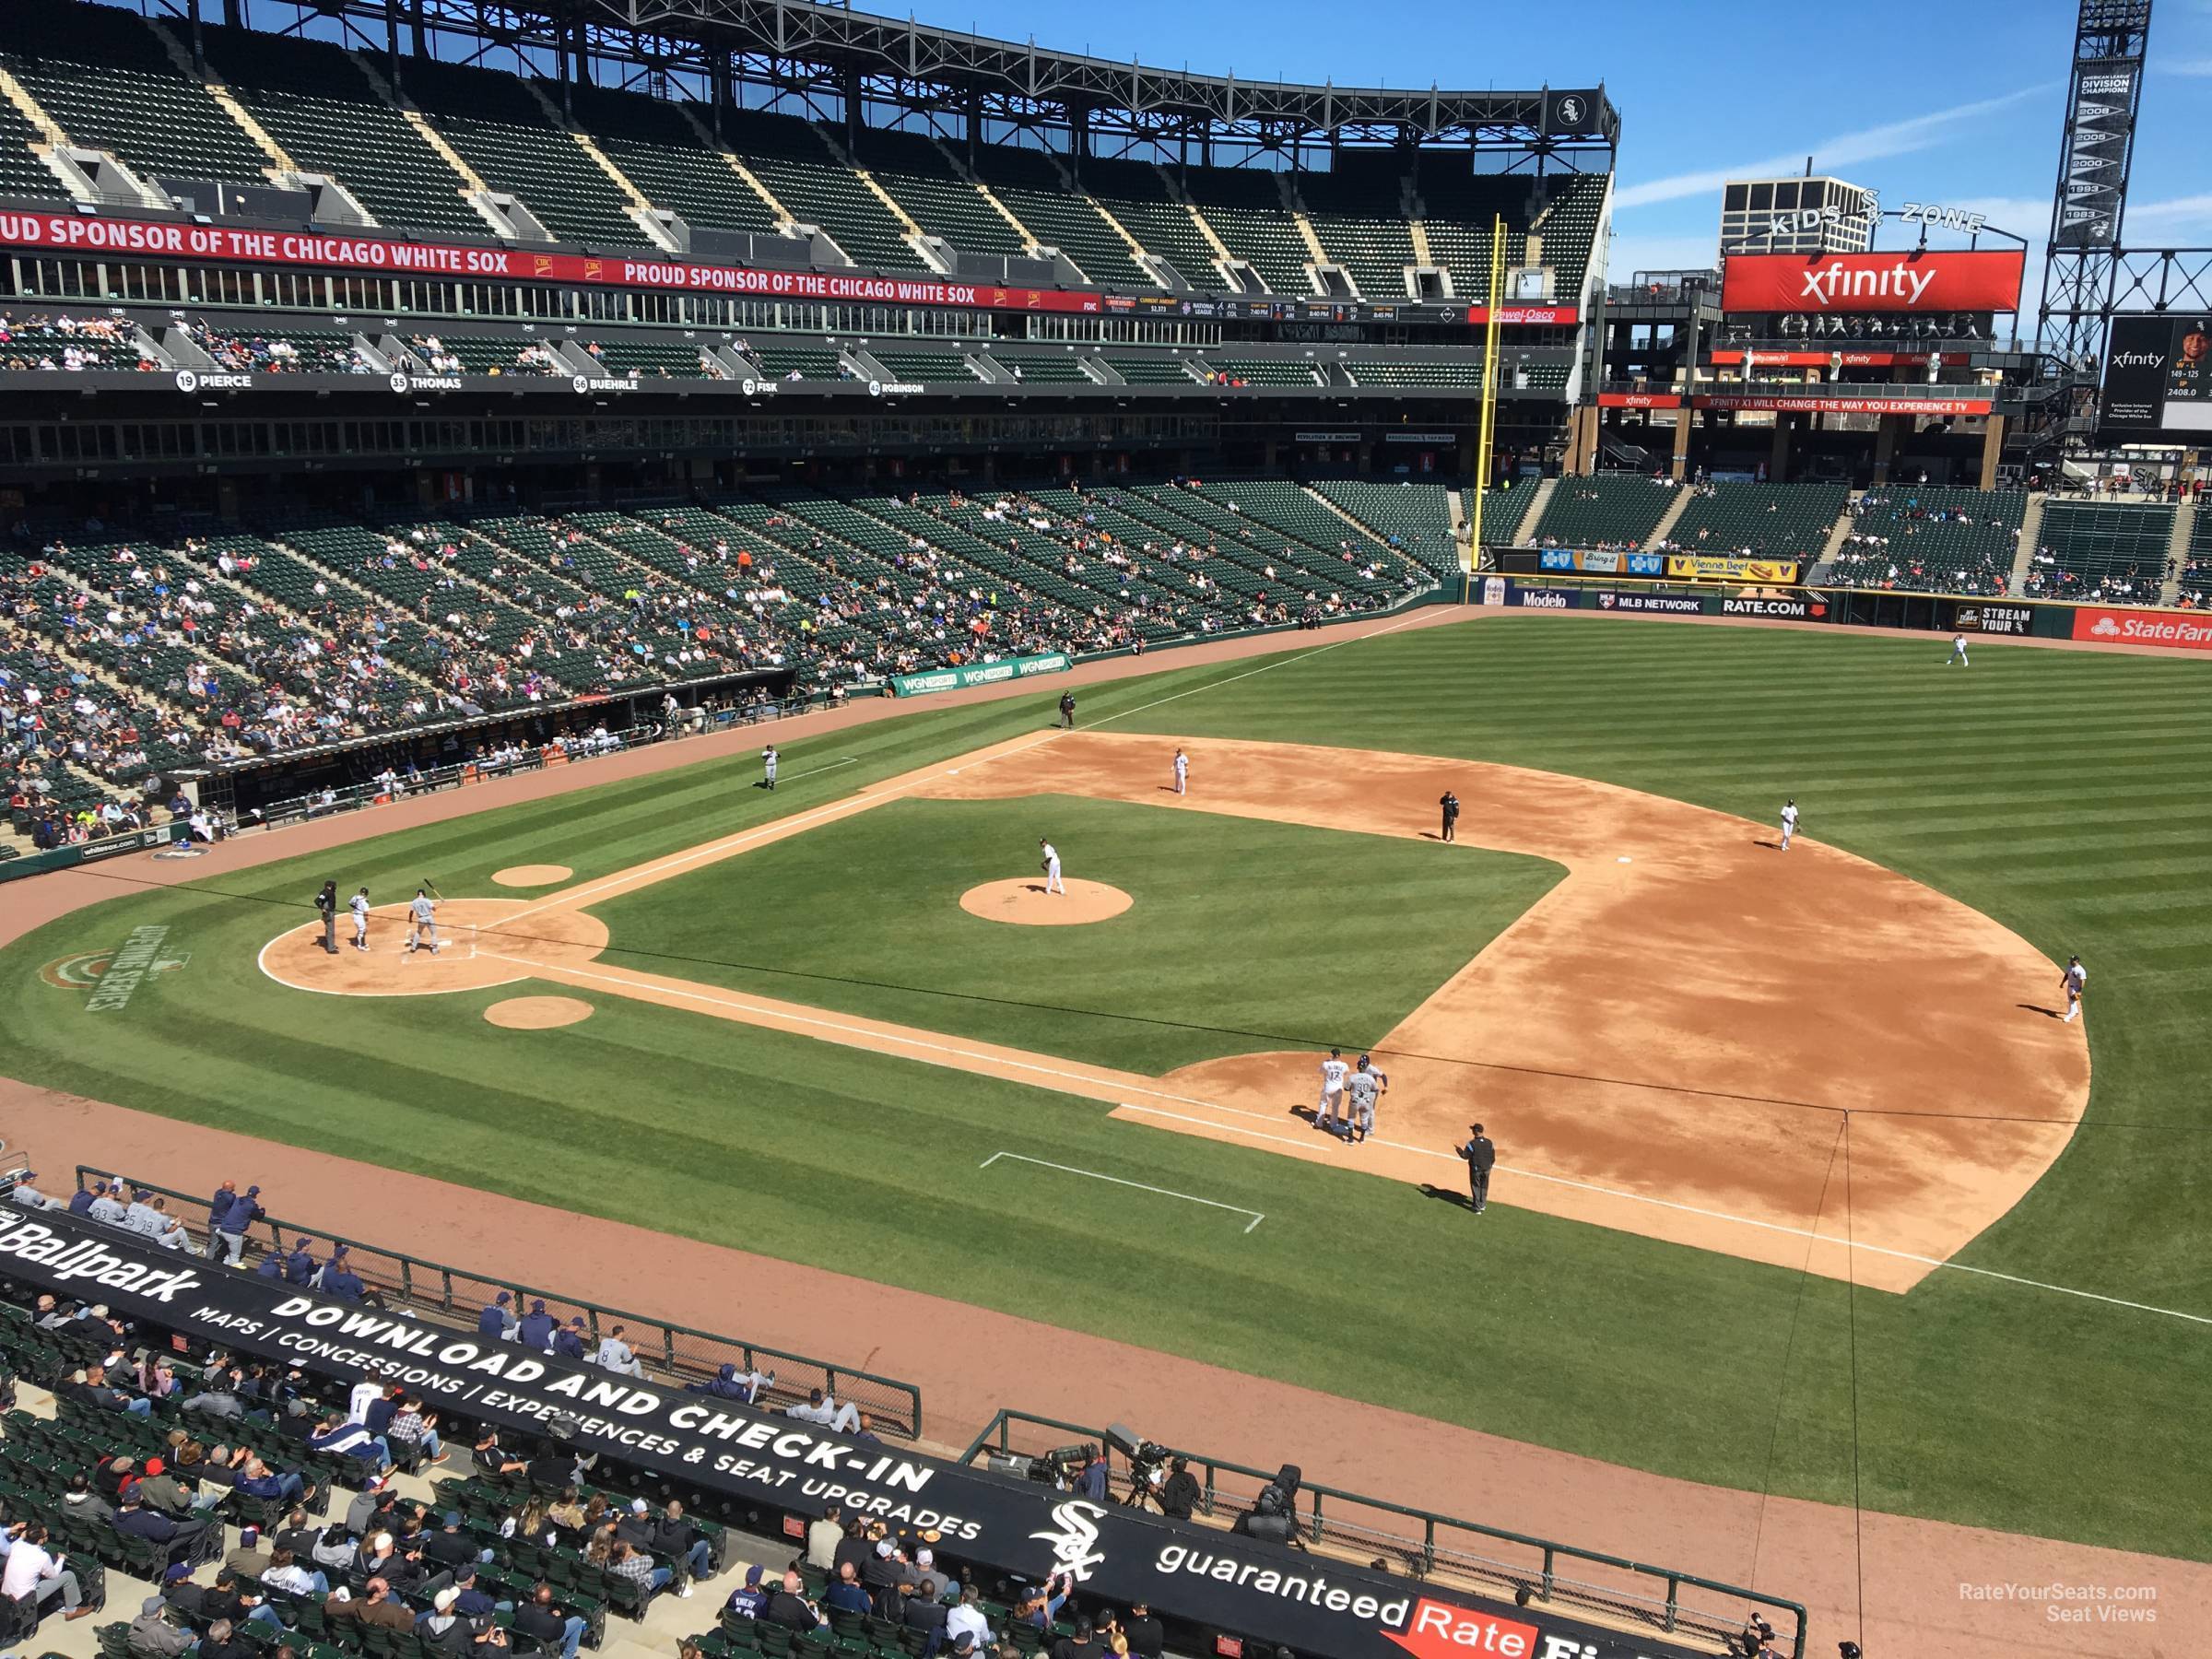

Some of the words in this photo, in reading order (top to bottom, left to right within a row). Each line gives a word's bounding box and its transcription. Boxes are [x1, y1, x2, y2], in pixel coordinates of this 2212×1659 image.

[2082, 79, 2129, 88] DIVISION
[2081, 87, 2128, 95] CHAMPIONS
[2079, 107, 2110, 115] 2008
[2073, 159, 2102, 168] 2000
[1770, 205, 1841, 237] KIDS
[1900, 202, 1986, 236] ZONE
[2066, 210, 2095, 218] 1983
[50, 219, 183, 251] SPONSOR
[190, 229, 222, 253] OF
[229, 232, 276, 257] THE
[283, 237, 385, 265] CHICAGO
[390, 245, 462, 270] WHITE
[467, 251, 509, 273] SOX
[625, 263, 686, 285] PROUD
[690, 267, 768, 290] SPONSOR
[772, 274, 793, 292] OF
[795, 276, 826, 294] THE
[830, 277, 894, 299] CHICAGO
[898, 282, 944, 302] WHITE
[947, 286, 975, 303] SOX
[1800, 262, 1936, 305] xfinity
[1084, 301, 1097, 311] FDIC
[1846, 355, 1871, 363] xfinity
[2112, 351, 2164, 368] xfinity
[2171, 370, 2183, 378] 149
[2188, 370, 2199, 378] 125
[180, 375, 192, 386] 19
[200, 375, 252, 388] PIERCE
[393, 378, 405, 387] 35
[410, 378, 462, 389] THOMAS
[575, 380, 586, 389] 56
[590, 380, 638, 390] BUEHRLE
[745, 383, 754, 393] 72
[757, 382, 778, 393] FISK
[870, 383, 879, 393] 42
[882, 383, 924, 394] ROBINSON
[2168, 388, 2196, 396] 2408.0
[1625, 395, 1653, 406] xfinity
[1710, 397, 1740, 407] XFINITY
[1753, 398, 1775, 408] WILL
[1777, 399, 1817, 409] CHANGE
[1819, 399, 1840, 409] THE
[1841, 400, 1864, 410] WAY
[1865, 400, 1888, 410] YOU
[1889, 401, 1952, 411] EXPERIENCE
[1954, 402, 1968, 411] TV
[1585, 553, 1607, 563] Bring
[1690, 559, 1724, 570] Vienna
[1726, 560, 1748, 571] Beef
[1524, 591, 1566, 608] Modelo
[1619, 597, 1642, 608] MLB
[1644, 598, 1700, 611] NETWORK
[1724, 600, 1805, 616] RATE.COM
[1983, 607, 2030, 621] STREAM
[1983, 618, 2012, 631] YOUR
[1018, 661, 1042, 675] WGN
[1042, 657, 1065, 669] SPORTS
[963, 669, 988, 683] WGN
[988, 667, 1012, 678] SPORTS
[903, 677, 929, 690] WGN
[929, 675, 956, 687] SPORTS
[84, 839, 135, 855] whitesox.com
[112, 924, 171, 969] OPENING
[85, 970, 144, 1011] SERIES
[95, 1207, 107, 1220] 33
[124, 1214, 135, 1227] 25
[0, 1223, 201, 1302] Ballpark
[601, 1349, 609, 1362] 8
[271, 1297, 547, 1383] DOWNLOAD
[543, 1373, 661, 1416] AND
[668, 1404, 935, 1492] CHECK-IN
[356, 1398, 362, 1413] 1
[190, 1306, 265, 1335] MAPS
[278, 1333, 465, 1394] CONCESSIONS
[682, 1446, 707, 1465] &
[713, 1454, 797, 1488] SEAT
[801, 1477, 982, 1540] UPGRADES
[1155, 1544, 1410, 1628] guaranteed
[1417, 1606, 1526, 1656] Rate
